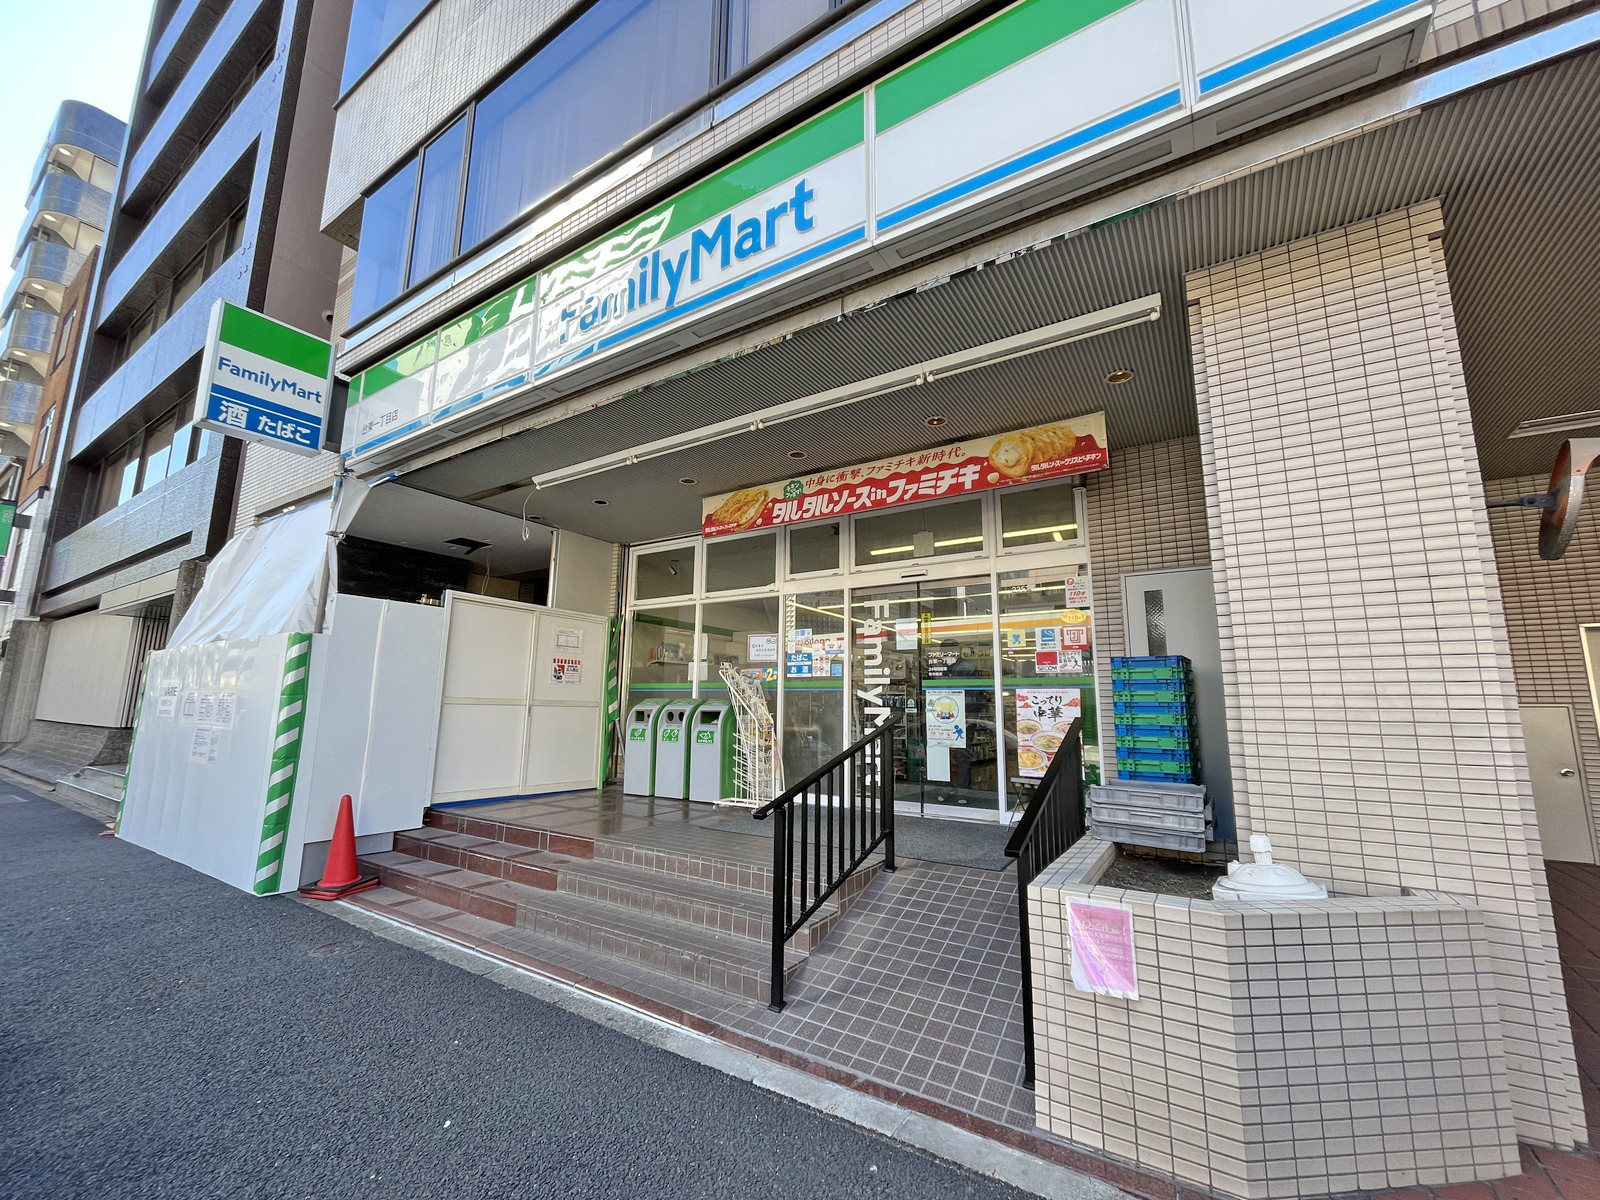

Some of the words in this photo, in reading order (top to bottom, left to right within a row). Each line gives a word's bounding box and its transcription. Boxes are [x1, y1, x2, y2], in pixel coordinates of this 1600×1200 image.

[558, 177, 816, 345] FamilyMart
[217, 356, 322, 404] FamilyMart
[218, 399, 250, 430] 酒
[257, 414, 312, 446] たばこ
[805, 446, 967, 489] 中身に衝撃、ファミチキ新時代。
[771, 463, 982, 525] タルタルソースinファミチキ
[790, 653, 809, 662] たばこ
[1031, 695, 1063, 706] こってり
[1033, 706, 1064, 723] 中華
